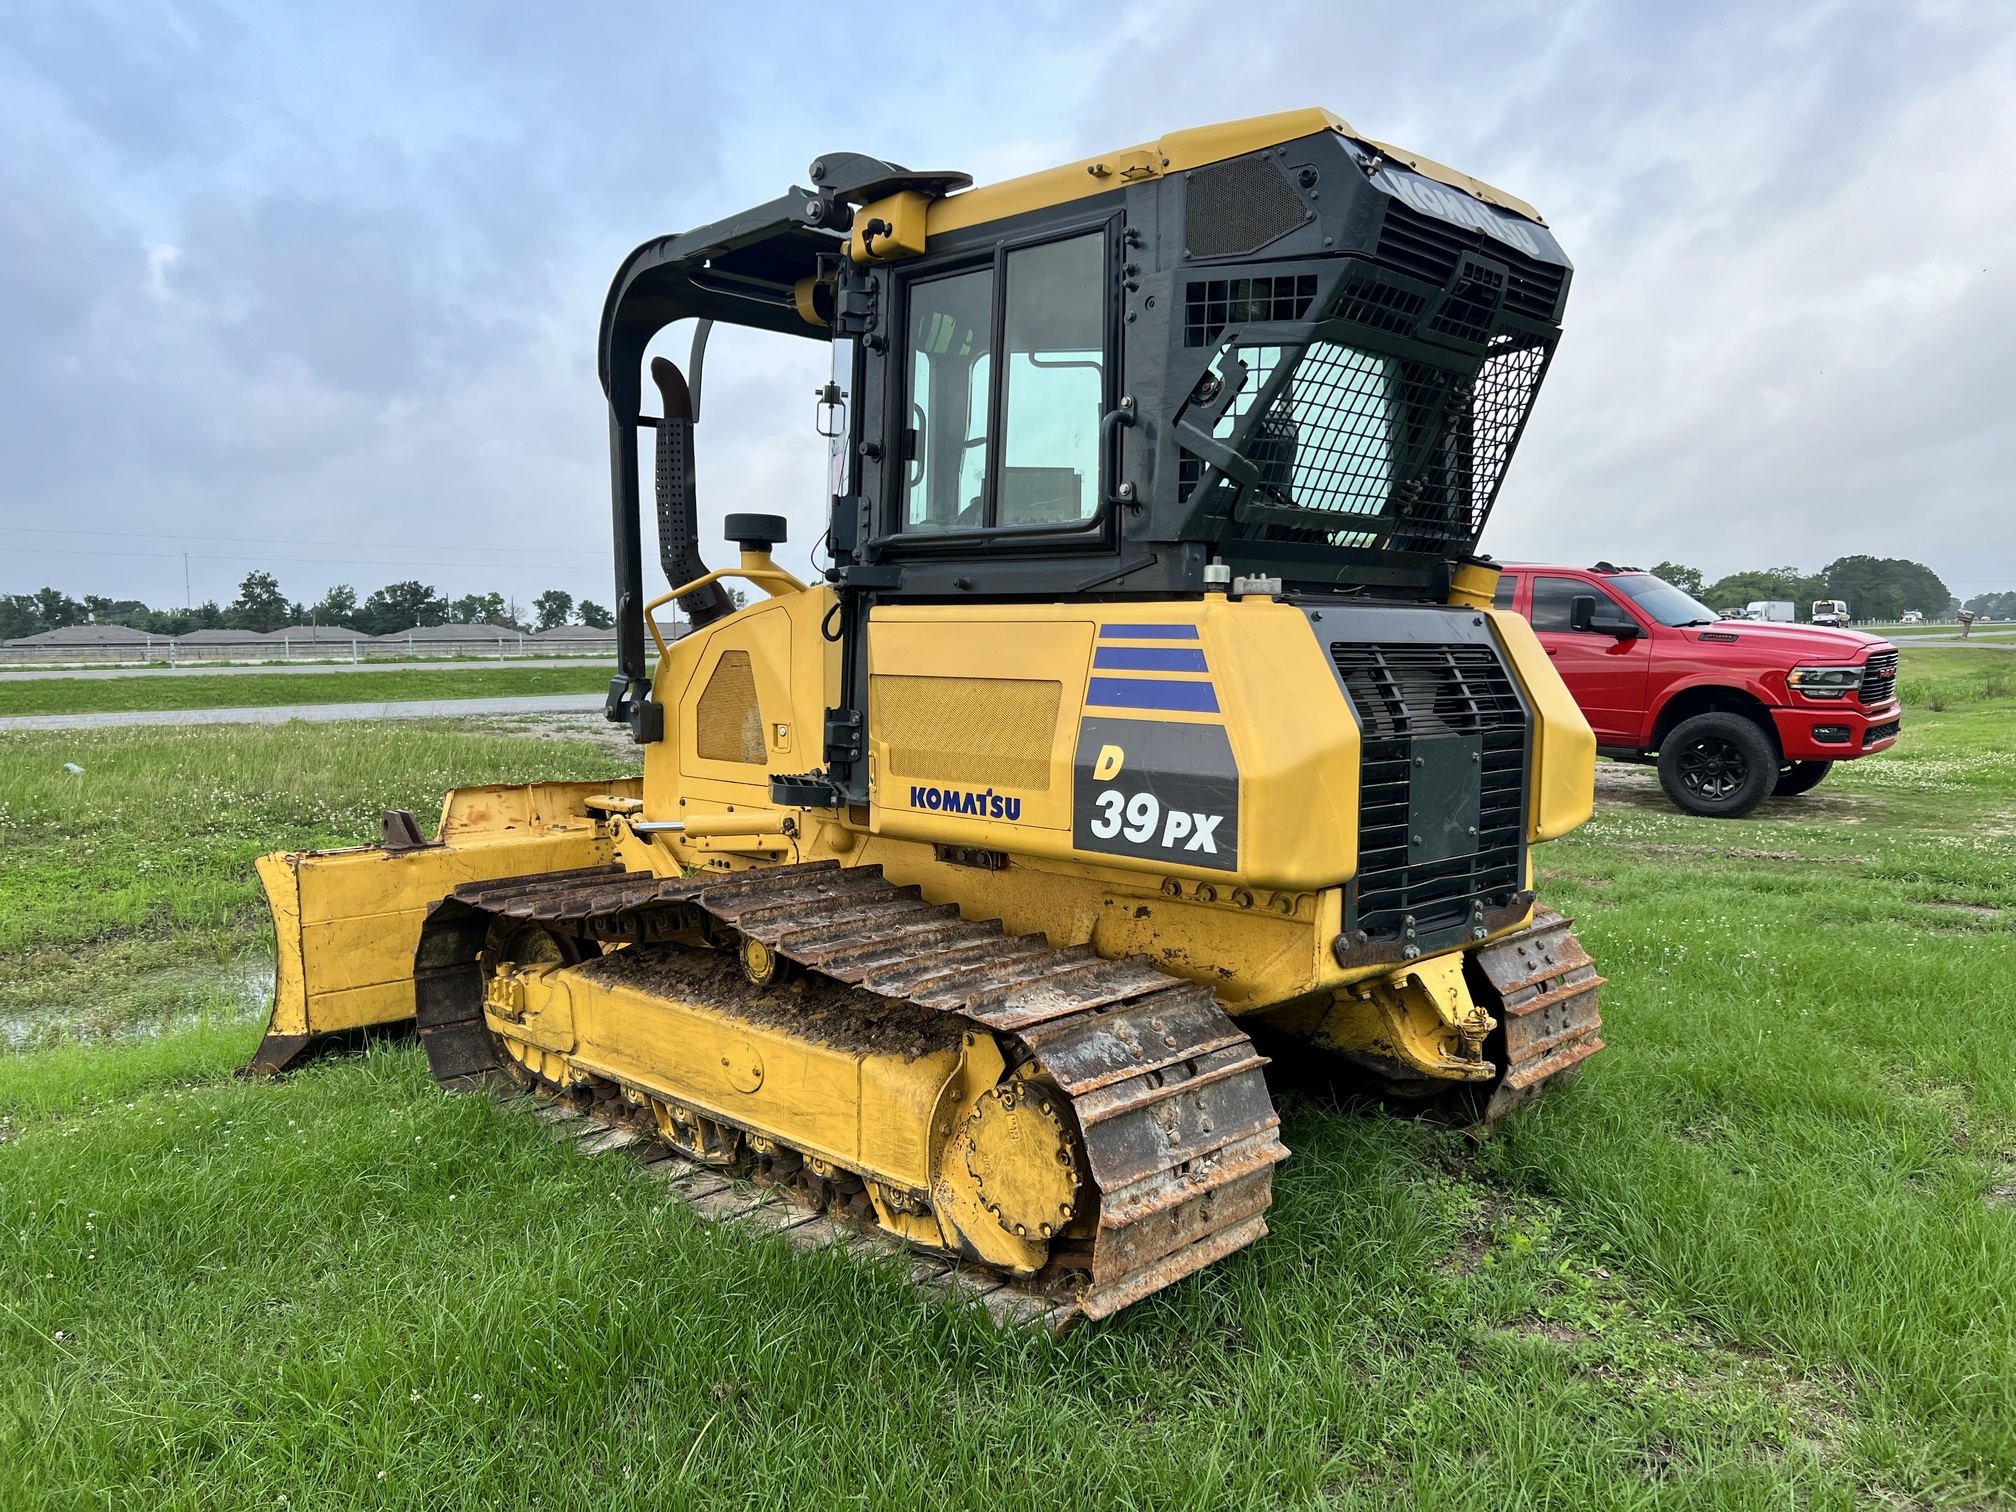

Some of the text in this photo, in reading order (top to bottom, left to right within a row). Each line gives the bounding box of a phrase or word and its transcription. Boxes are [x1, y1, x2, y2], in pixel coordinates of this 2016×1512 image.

[1383, 168, 1540, 255] KOMATSU
[1093, 744, 1124, 781] D
[911, 786, 1020, 820] KOMATSU
